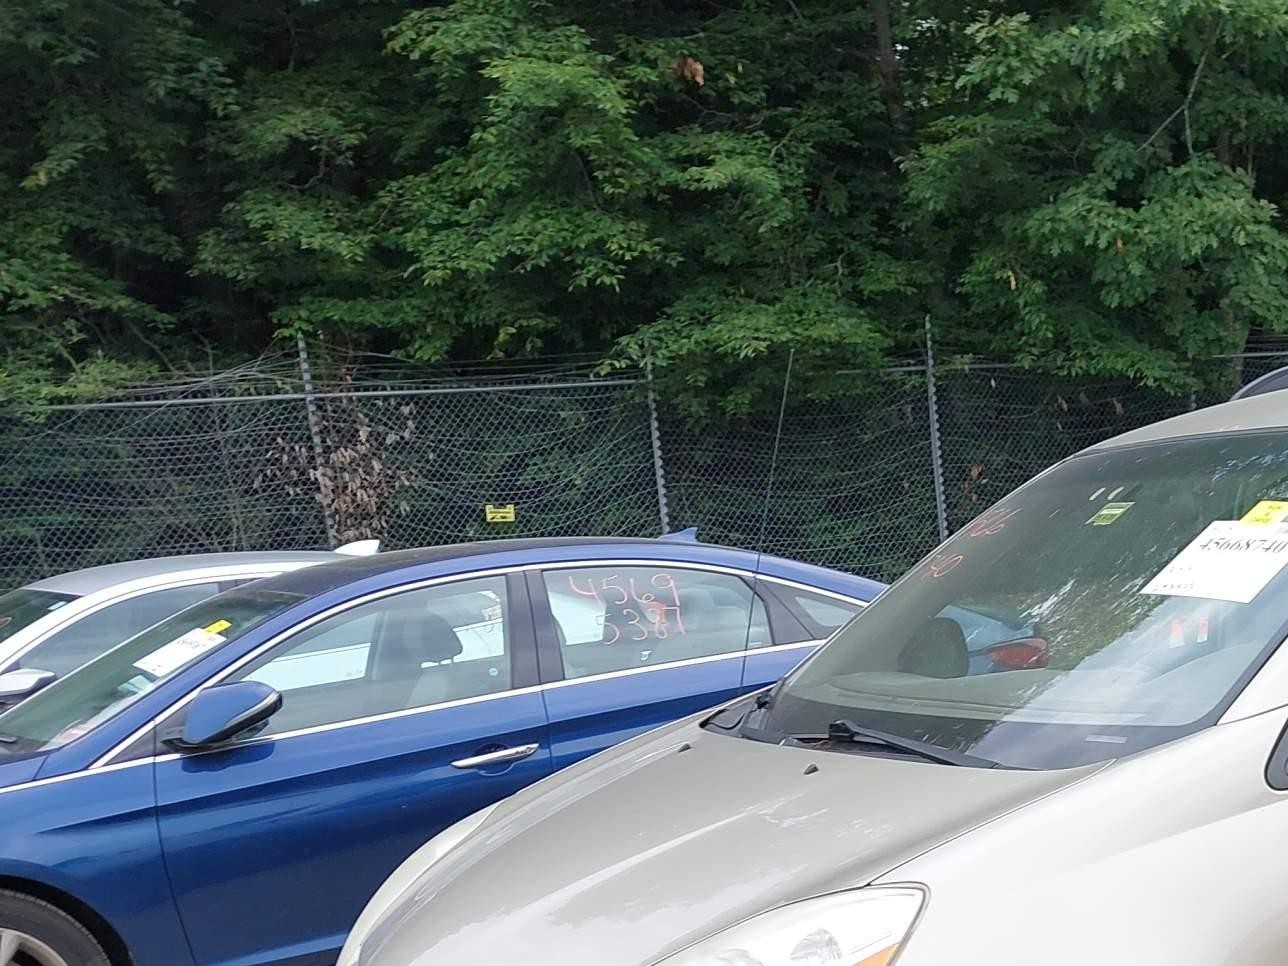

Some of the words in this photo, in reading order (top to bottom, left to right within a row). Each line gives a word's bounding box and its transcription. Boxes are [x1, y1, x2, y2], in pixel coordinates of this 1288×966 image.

[1200, 537, 1288, 553] 45668740
[568, 573, 681, 606] 4569
[595, 606, 686, 645] 5387
